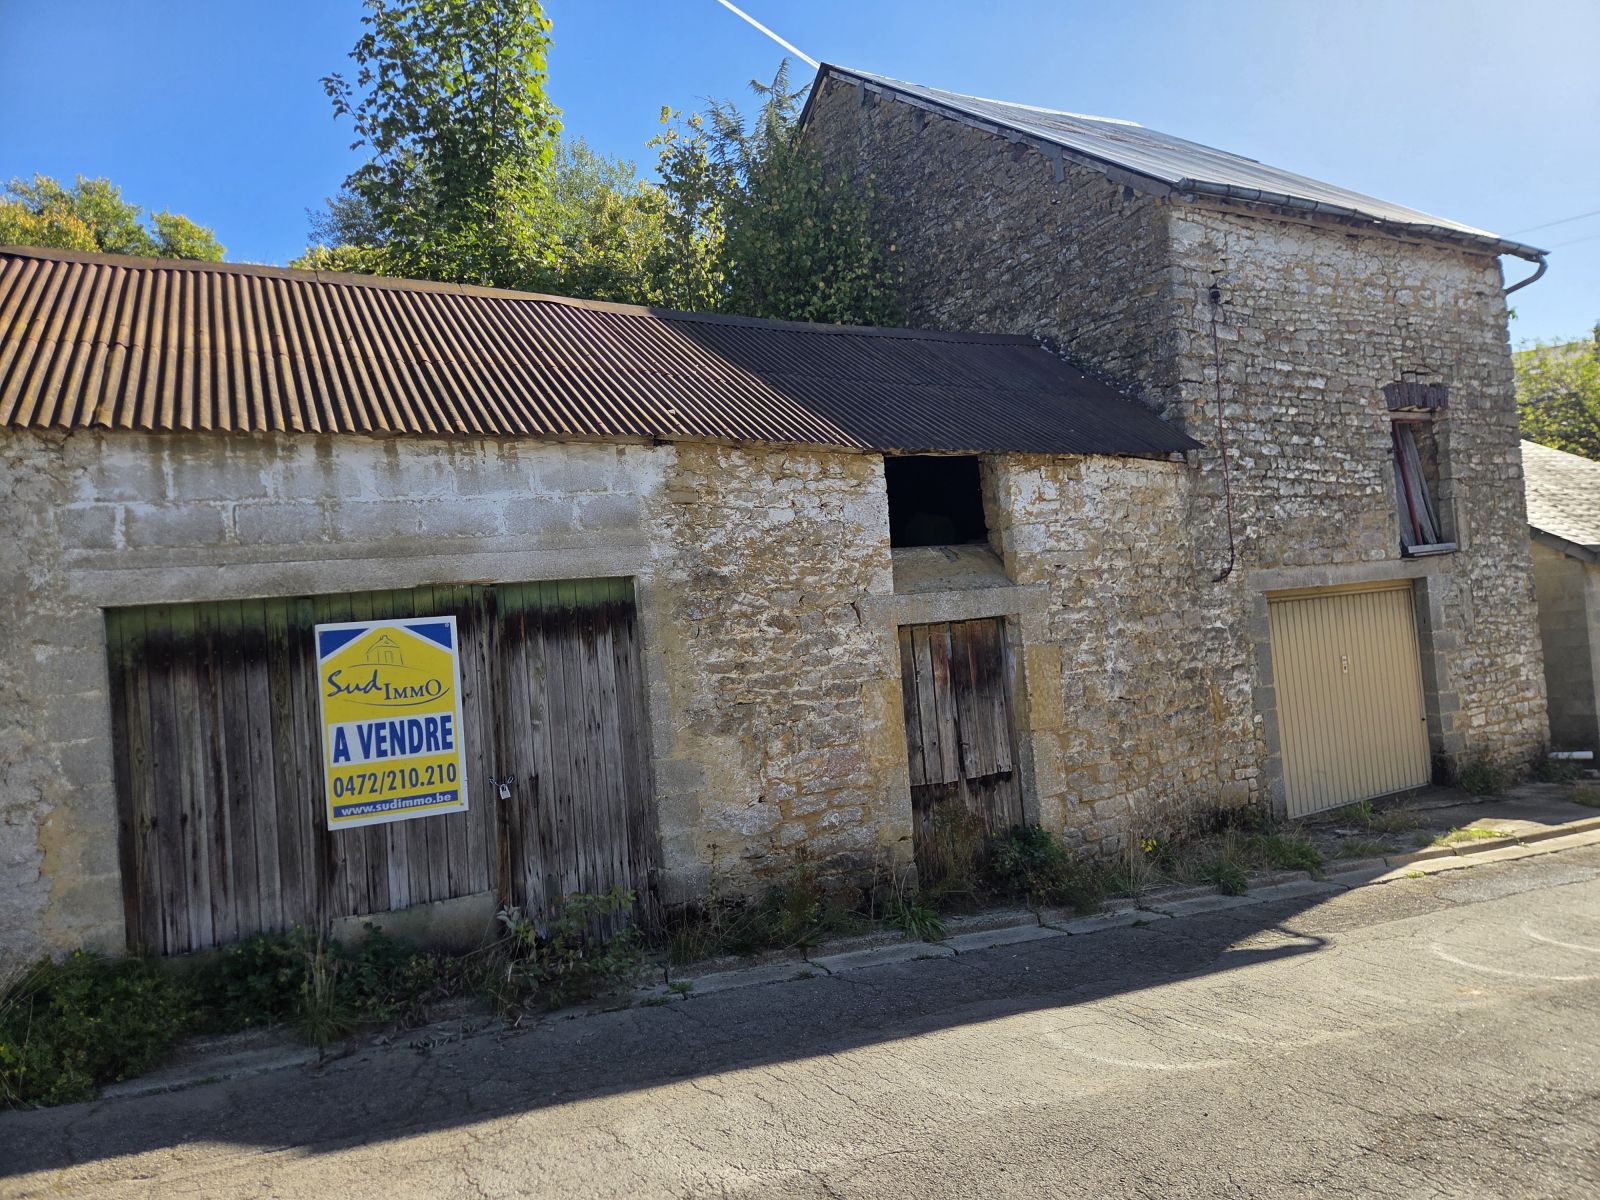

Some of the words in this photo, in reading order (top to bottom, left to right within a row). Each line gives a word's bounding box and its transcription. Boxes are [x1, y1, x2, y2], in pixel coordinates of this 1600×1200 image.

[327, 669, 382, 697] Sud
[383, 679, 442, 700] IMMO
[333, 726, 352, 764] A
[356, 715, 454, 760] VENDRE
[333, 762, 457, 798] 0472/210.210
[341, 793, 452, 816] www.sudimmo.be
